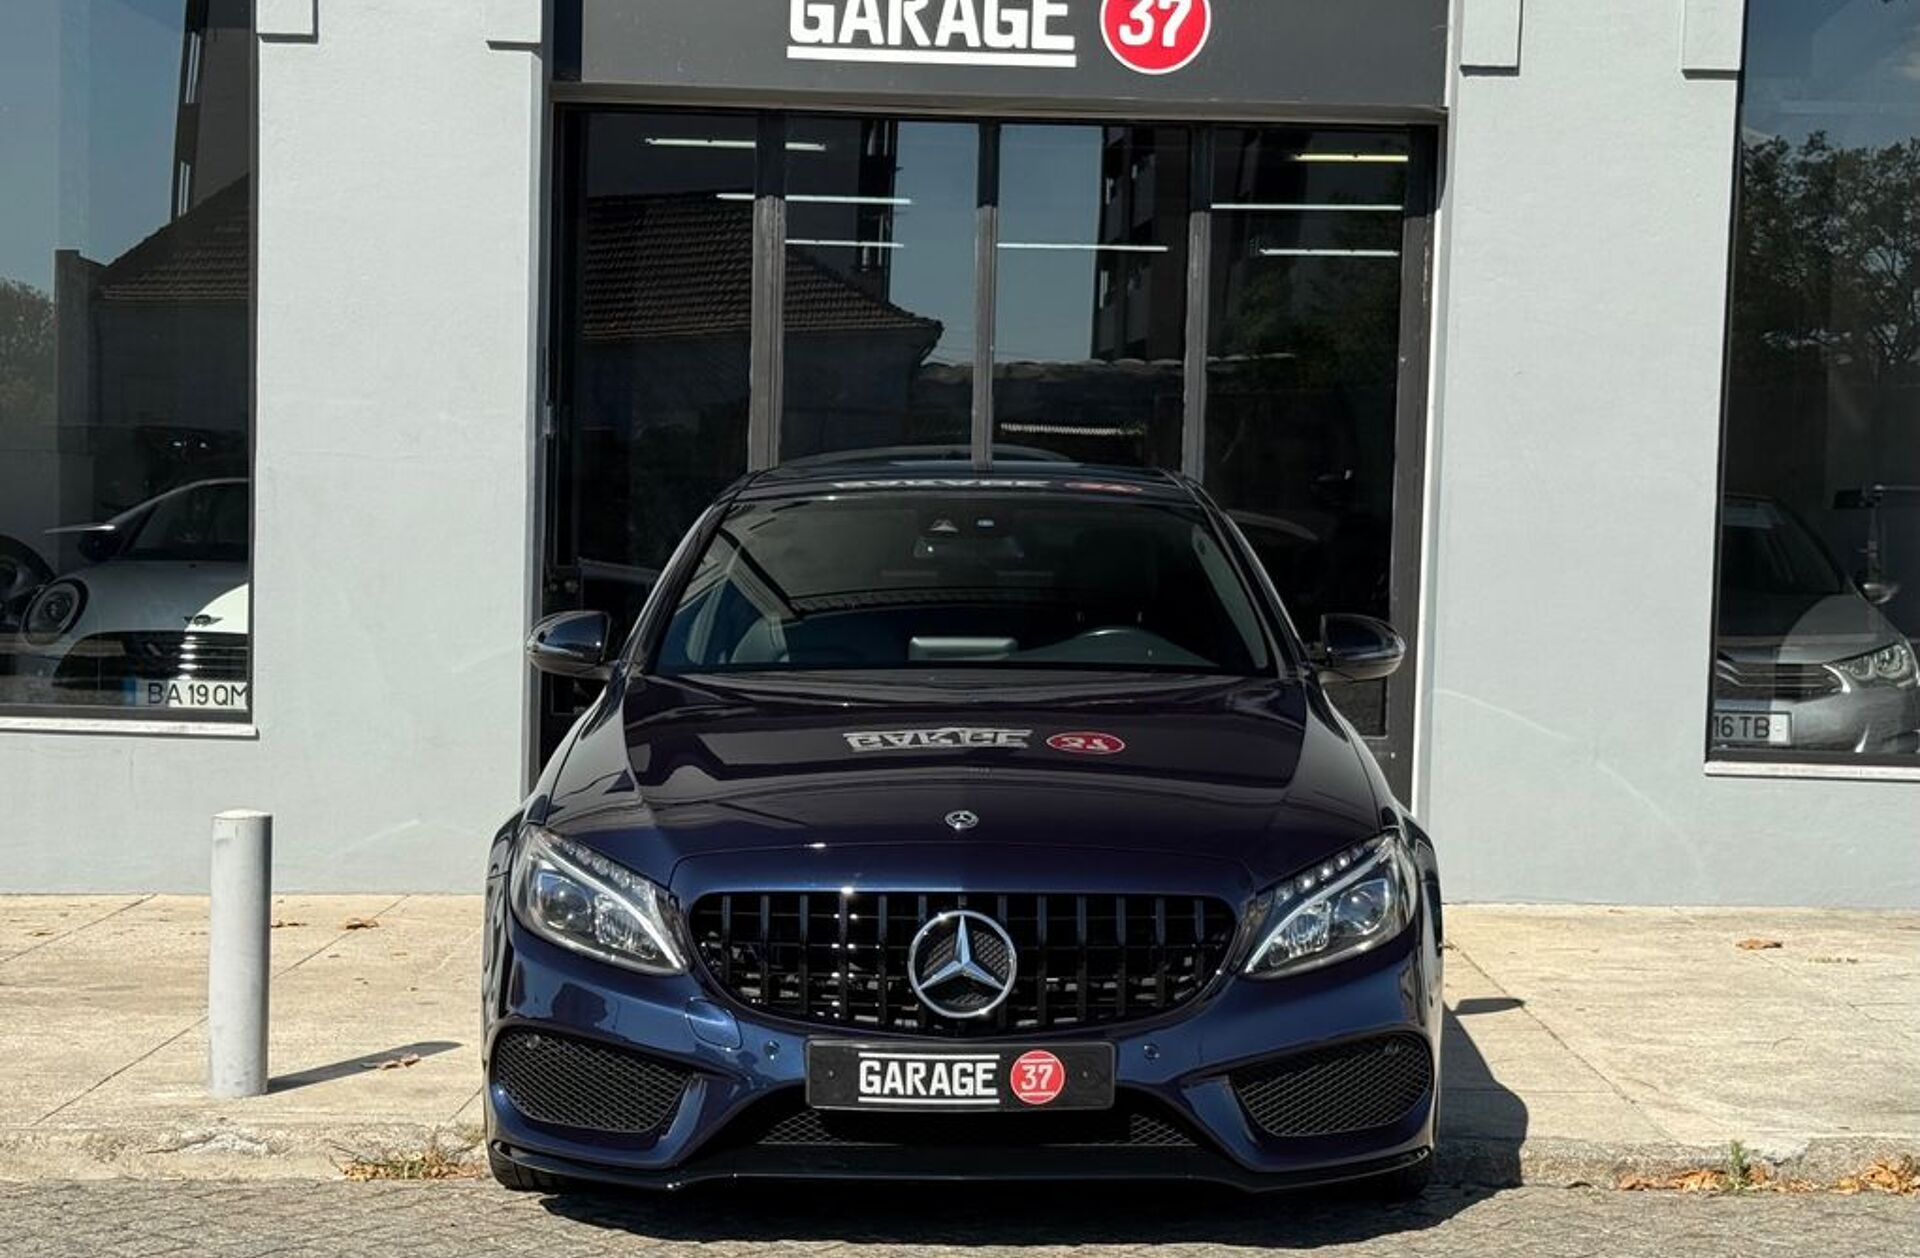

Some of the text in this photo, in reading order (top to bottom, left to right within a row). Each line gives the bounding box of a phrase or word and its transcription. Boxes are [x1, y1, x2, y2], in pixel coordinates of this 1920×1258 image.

[790, 0, 1192, 50] GARAGE 37
[148, 682, 247, 706] BA 19 QM
[1739, 715, 1770, 737] TB
[859, 1060, 1053, 1095] GARAGE 37
